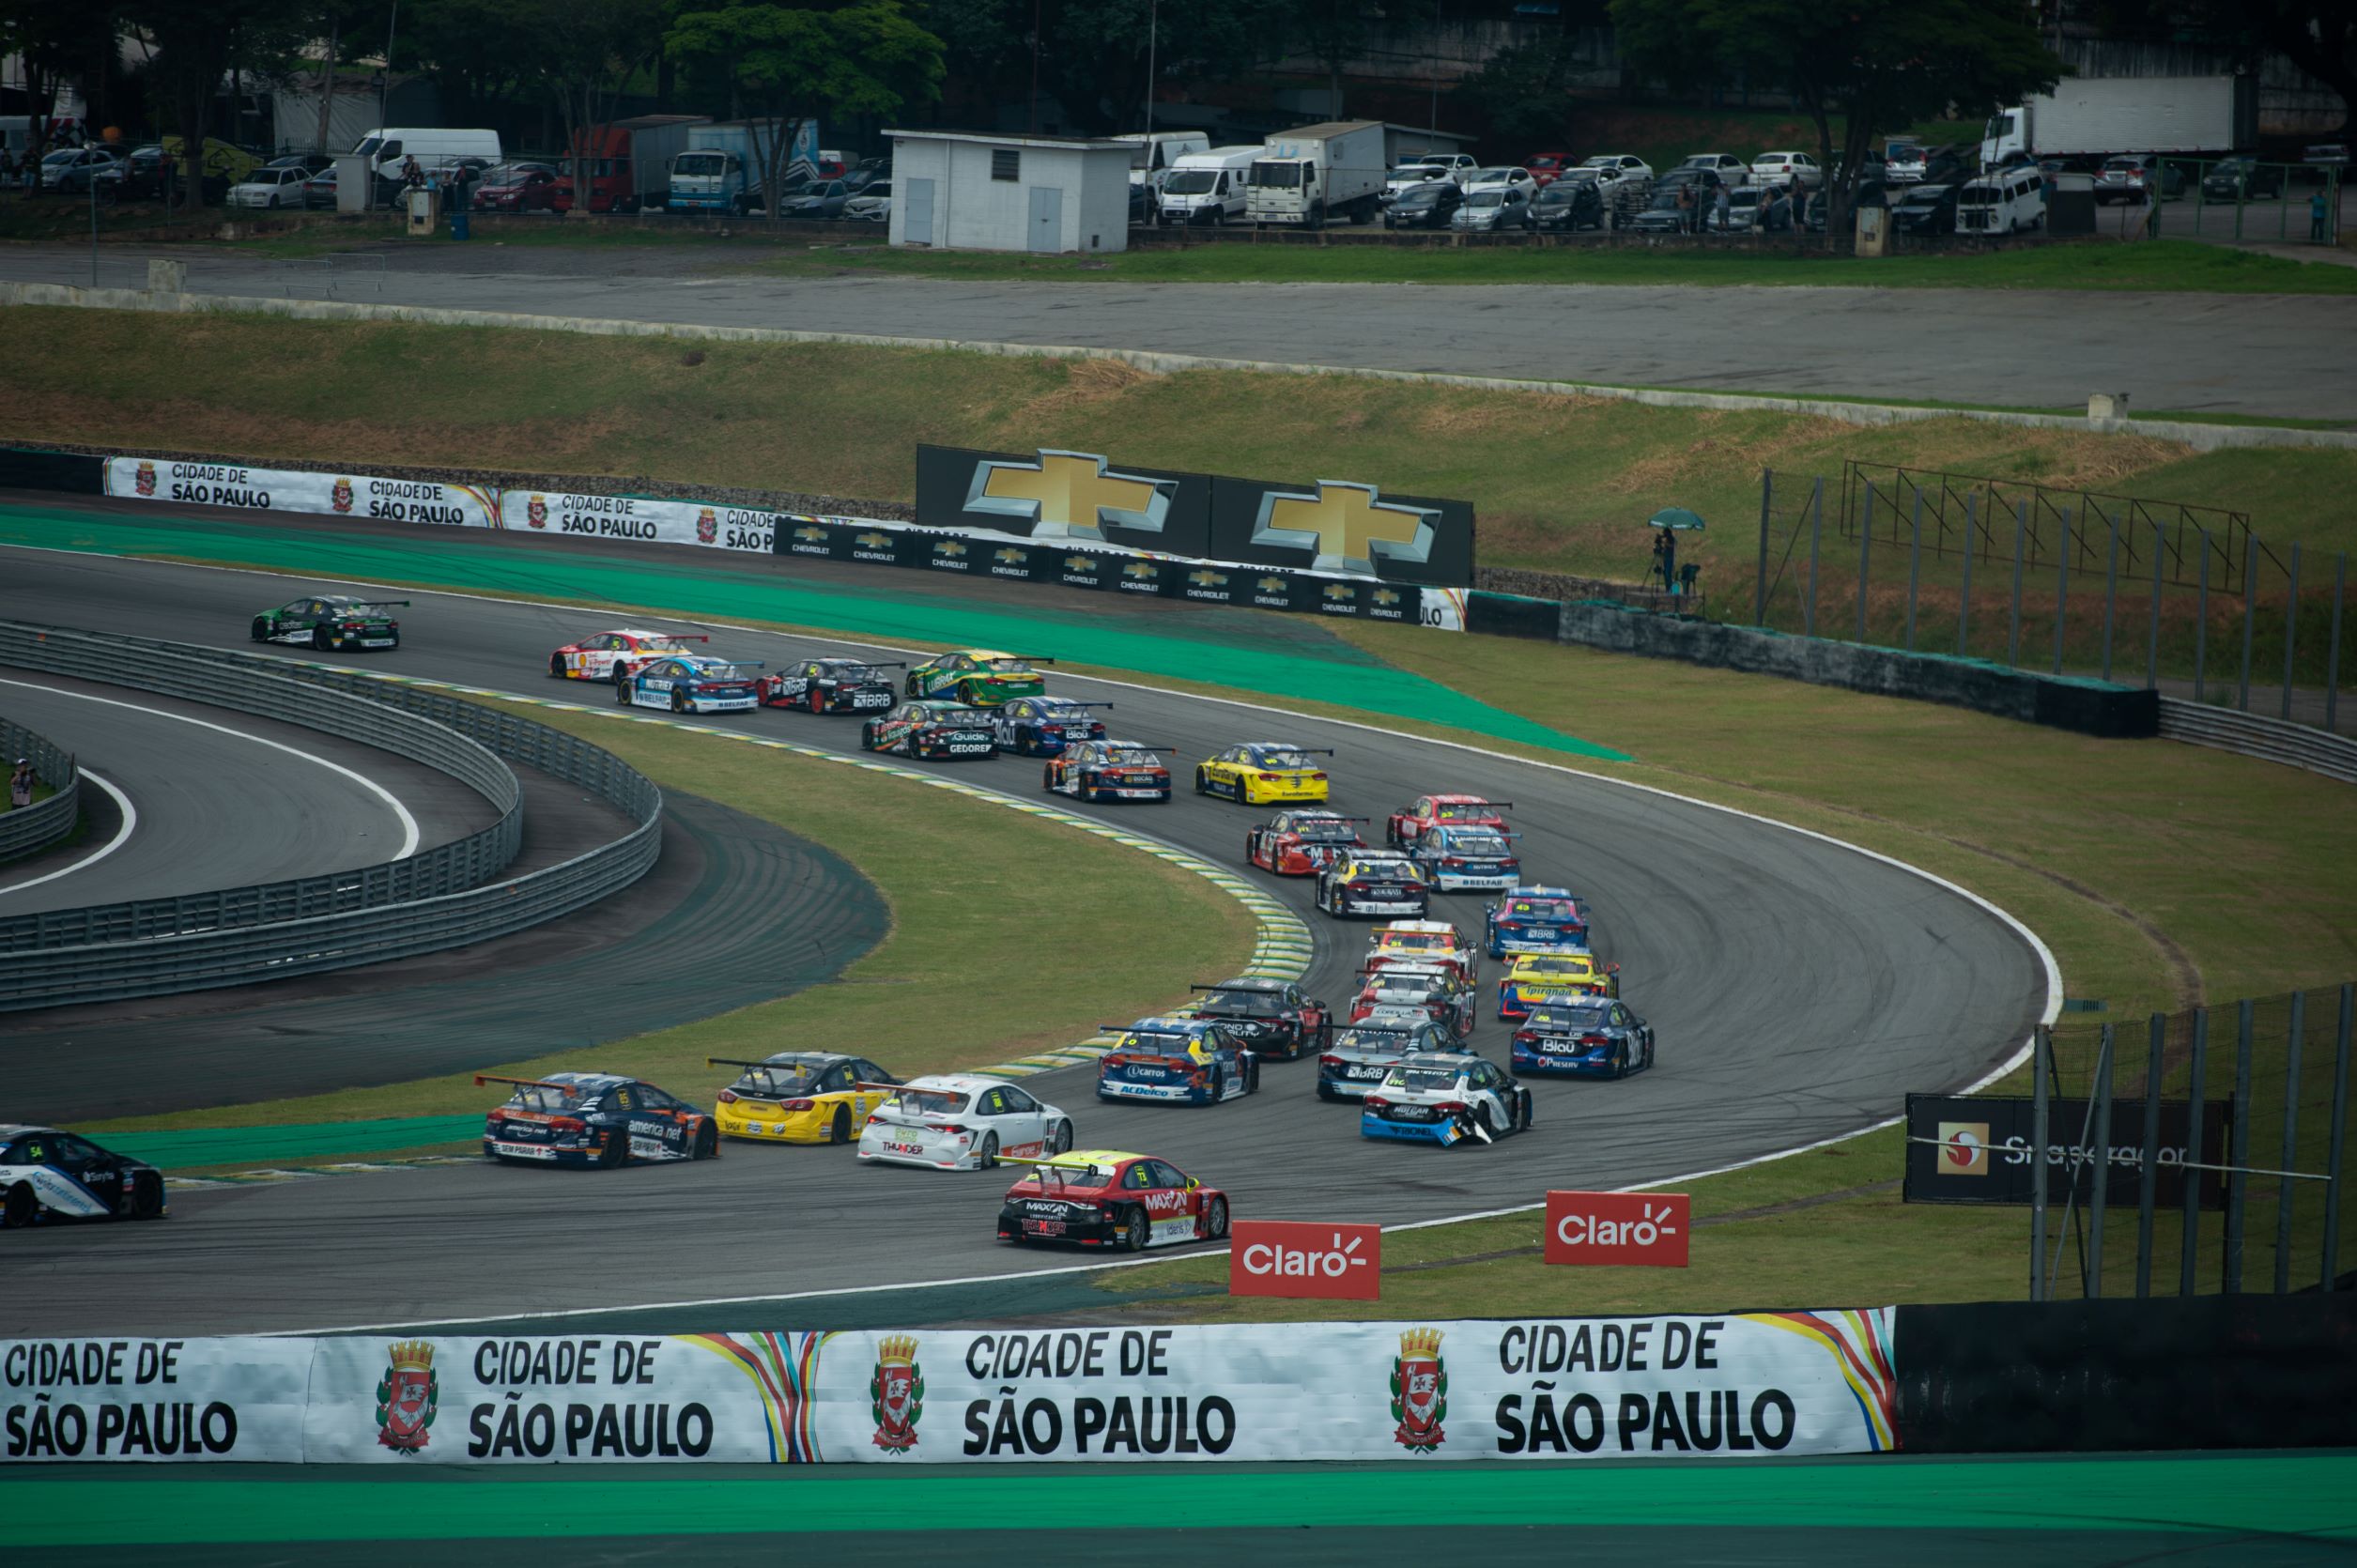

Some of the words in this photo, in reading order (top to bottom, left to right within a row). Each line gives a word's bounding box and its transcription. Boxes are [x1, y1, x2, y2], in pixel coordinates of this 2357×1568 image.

[172, 463, 224, 483] CIDADE
[232, 469, 248, 484] DE
[172, 482, 208, 503] SÃO
[212, 487, 270, 509] PAULO
[369, 480, 422, 500] CIDADE
[423, 484, 443, 500] DE
[369, 499, 406, 520] SÃO
[408, 503, 463, 524] PAULO
[562, 494, 613, 514] CIDADE
[615, 498, 635, 515] DE
[562, 512, 596, 533] SÃO
[600, 517, 656, 540] PAULO
[727, 510, 774, 529] CIDADE
[727, 528, 761, 549] SÃO
[792, 544, 830, 555] CHEVROLET
[853, 550, 895, 562] CHEVROLET
[932, 559, 968, 571] CHEVROLET
[992, 566, 1029, 577] CHEVROLET
[1063, 574, 1098, 586] CHEVROLET
[1120, 581, 1159, 592] CHEVROLET
[1187, 589, 1229, 600] CHEVROLET
[1255, 595, 1288, 607] CHEVROLET
[1322, 603, 1356, 614] CHEVROLET
[1370, 607, 1402, 619] CHEVROLET
[791, 678, 807, 695] BRB
[867, 694, 890, 707] BRB
[953, 731, 985, 742] Guide
[949, 744, 987, 753] GEDORE
[1537, 929, 1555, 939] BRB
[1359, 1066, 1384, 1080] BRB
[883, 1142, 923, 1155] THUNDER
[1026, 1202, 1069, 1213] MAXON
[1022, 1219, 1066, 1234] THUNDER
[1558, 1215, 1657, 1246] Claro
[1243, 1244, 1347, 1277] Claro
[965, 1330, 1104, 1379] CIDADE
[1120, 1330, 1172, 1376] DE
[1496, 1319, 1656, 1374] CIDADE
[1662, 1321, 1724, 1370] DE
[5, 1340, 128, 1387] CIDADE
[135, 1341, 183, 1384] DE
[474, 1340, 602, 1385] CIDADE
[612, 1340, 661, 1385] DE
[7, 1393, 87, 1457] SÃO
[97, 1401, 237, 1455] PAULO
[469, 1391, 555, 1458] SÃO
[565, 1402, 713, 1457] PAULO
[963, 1385, 1062, 1456] SÃO
[1074, 1395, 1236, 1454] PAULO
[1496, 1380, 1599, 1454] SÃO
[1618, 1389, 1795, 1452] PAULO
